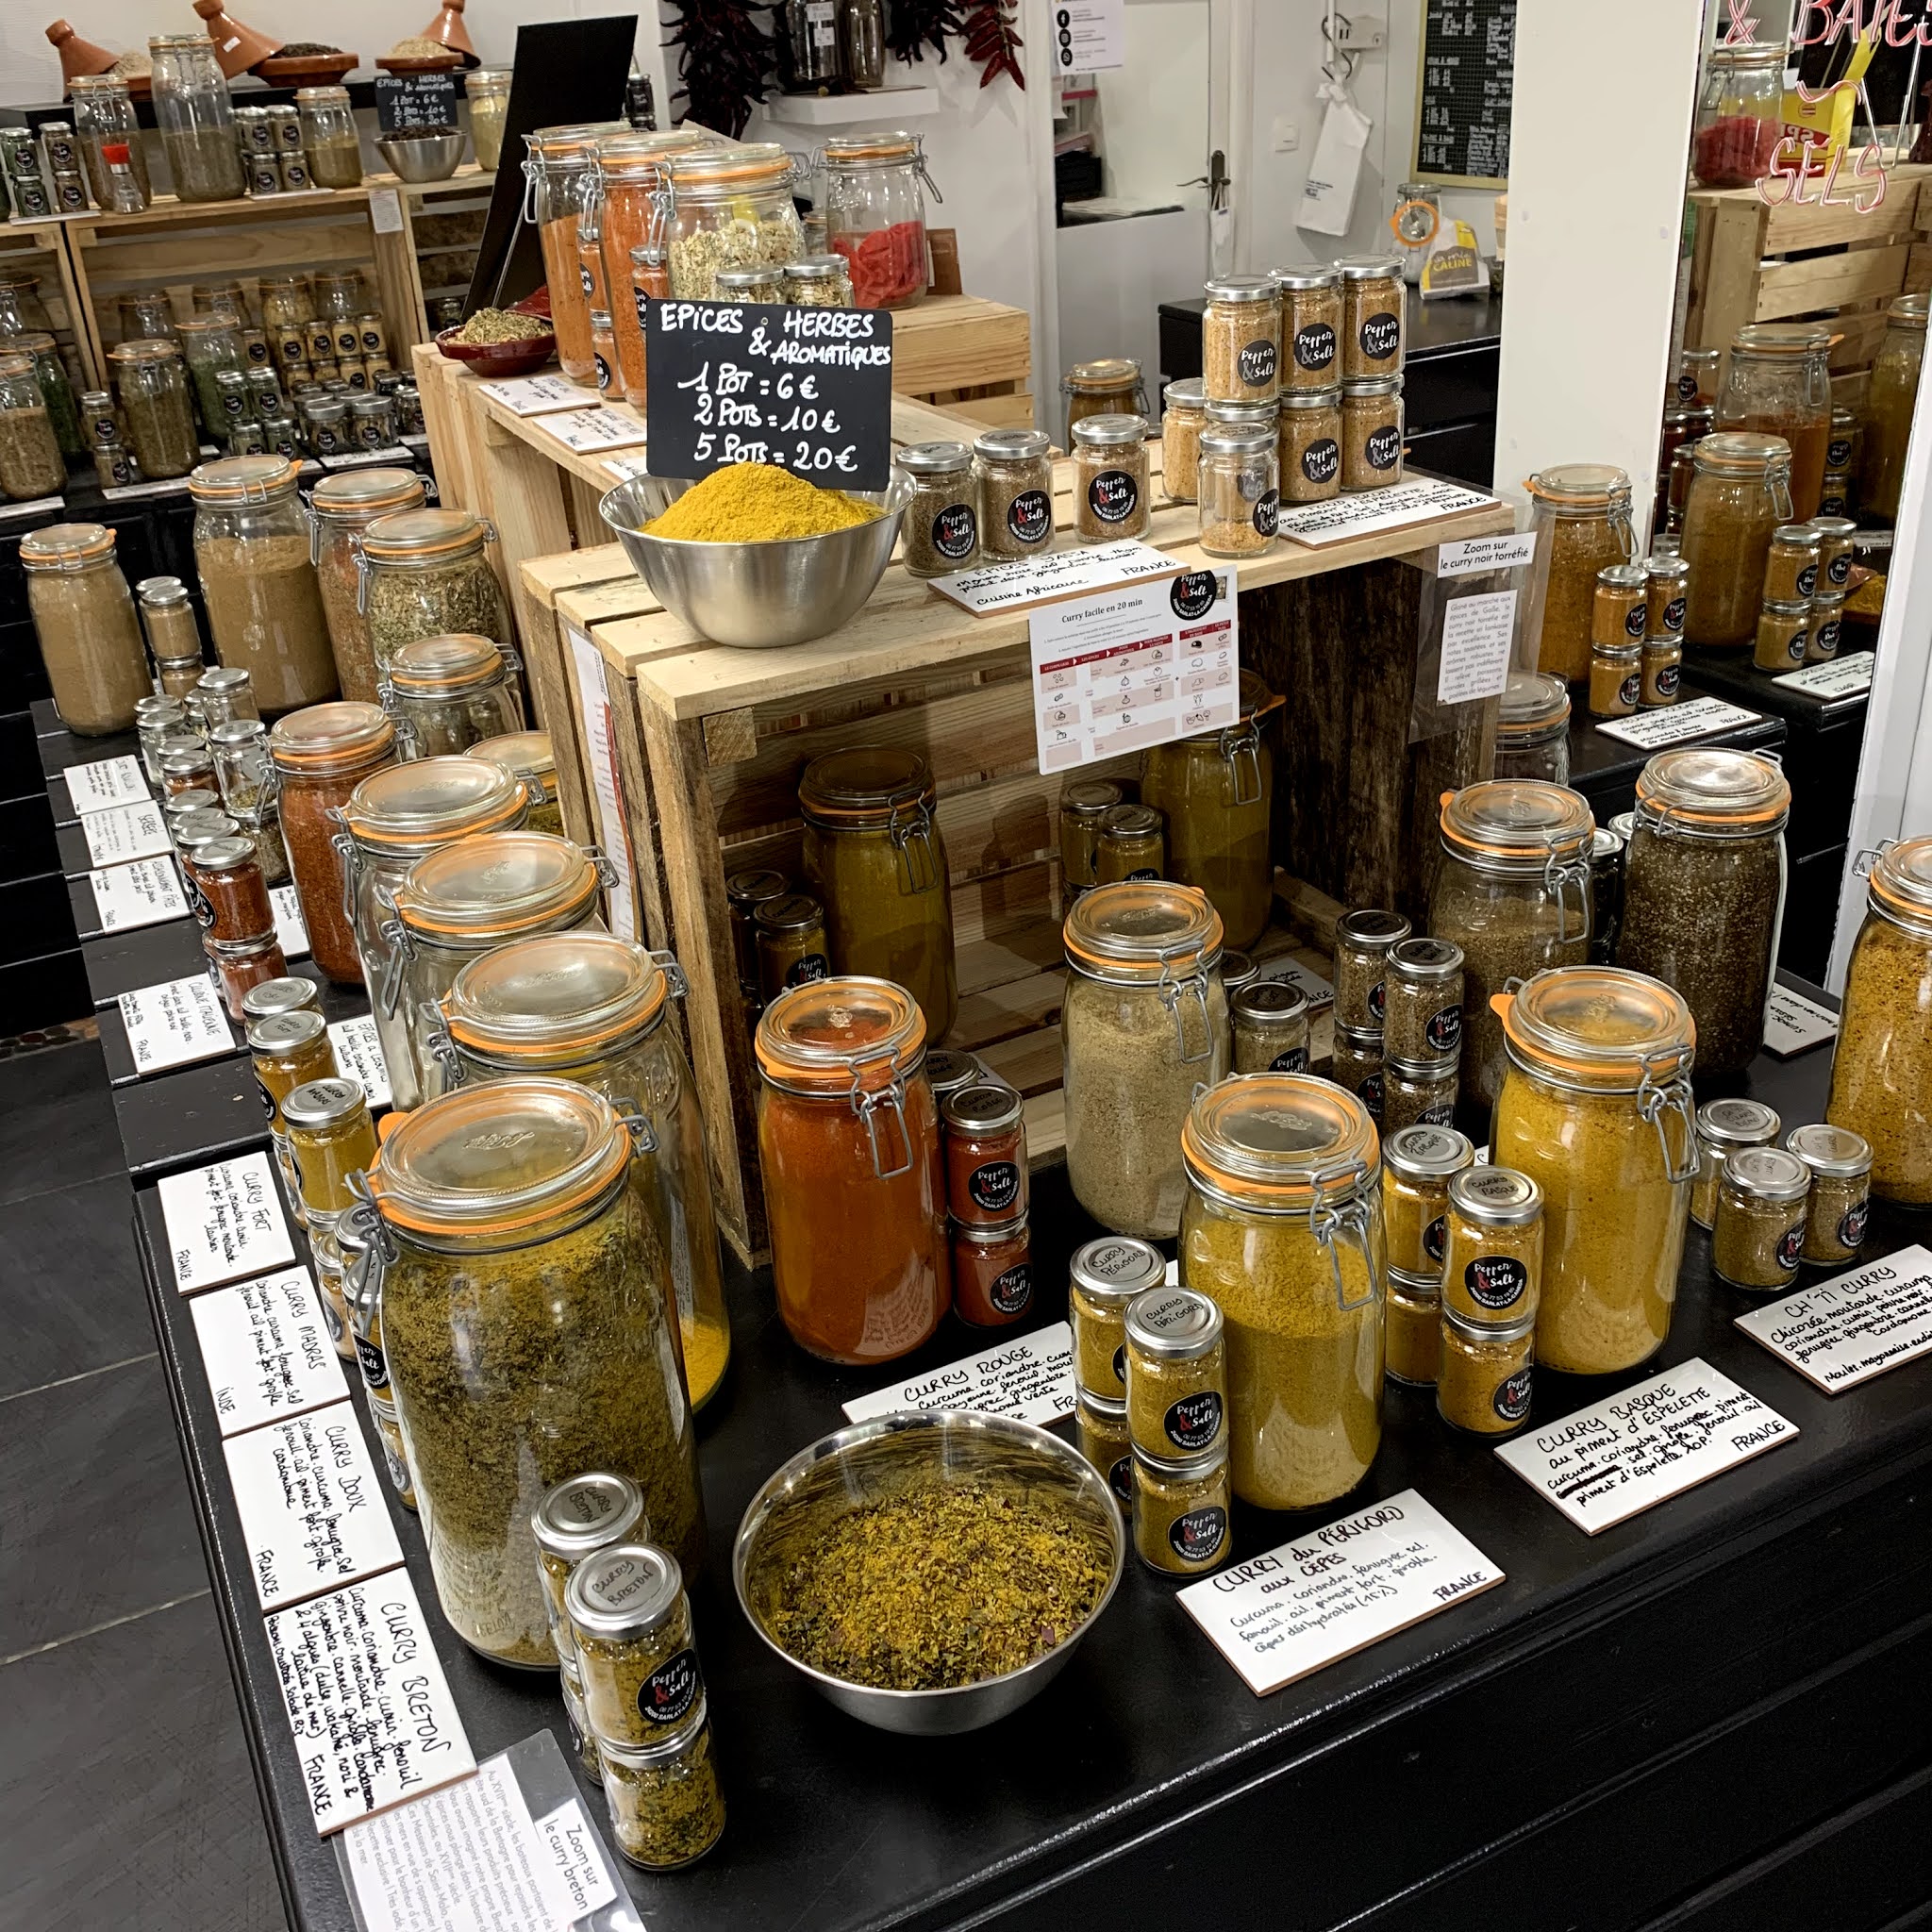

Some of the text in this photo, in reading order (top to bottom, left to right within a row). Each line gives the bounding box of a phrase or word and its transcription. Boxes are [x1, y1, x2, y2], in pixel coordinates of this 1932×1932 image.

[1755, 136, 1887, 214] SELS
[783, 309, 874, 339] HERBES
[1364, 321, 1398, 337] Pepper
[749, 327, 772, 356] &
[1299, 330, 1334, 349] Pepper
[1367, 334, 1398, 355] & Salt
[1241, 344, 1274, 363] Pepper
[1301, 345, 1334, 365] & Salt
[677, 361, 709, 391] 1
[716, 363, 754, 395] POT
[1242, 362, 1274, 380] & Salt
[693, 393, 713, 425] 2
[717, 398, 762, 426] POTS
[693, 432, 717, 460] 5
[717, 434, 768, 463] POTS
[1306, 444, 1337, 462] Pepper
[1308, 458, 1338, 479] & Salt
[1096, 476, 1126, 491] Pepper
[1015, 496, 1043, 511] Pepper
[1099, 488, 1128, 504] & Salt
[1440, 496, 1488, 511] FRANCE
[1017, 508, 1044, 525] & Salt
[1441, 545, 1529, 571] le curry noir torréfié
[1463, 541, 1508, 555] Zoom sur
[1121, 559, 1177, 576] FRANCE
[1180, 573, 1208, 584] Pepper
[1188, 585, 1208, 597] Salt
[1061, 598, 1144, 624] Curry facile en 20 min
[977, 1167, 1008, 1182] Pepper
[991, 1177, 1012, 1191] Salt
[242, 1172, 272, 1231] CURRY FORT
[175, 1249, 192, 1281] FRANCE
[1091, 1246, 1126, 1269] CURRY
[1474, 1263, 1512, 1276] Pepper
[1477, 1273, 1515, 1289] & Salt
[1840, 1266, 1897, 1294] CURRY
[280, 1280, 326, 1370] CURRY MADRAS
[904, 1346, 1033, 1403] CURRY ROUGE
[1176, 1398, 1212, 1417] Pepper
[1537, 1383, 1677, 1454] CURRY BASQUE
[1179, 1409, 1214, 1431] & Salt
[1730, 1420, 1786, 1452] FRANCE
[1549, 1455, 1574, 1470] au
[1574, 1430, 1623, 1460] piment
[325, 1425, 367, 1513] CURRY DOUX
[1575, 1480, 1617, 1507] piment
[1181, 1511, 1218, 1530] Pepper
[1183, 1523, 1218, 1543] & Salt
[256, 1549, 279, 1597] FRANCE
[591, 1559, 635, 1594] CURRY
[1213, 1555, 1284, 1593] CURRY
[1291, 1541, 1322, 1562] du
[608, 1562, 654, 1606] BRETON
[1260, 1574, 1296, 1594] aux
[1432, 1571, 1488, 1603] FRANCE
[1315, 1587, 1356, 1610] piment
[380, 1603, 452, 1753] CURRY BRETON
[652, 1658, 688, 1688] Pepper
[669, 1670, 690, 1697] Salt
[304, 1692, 315, 1708] de
[304, 1753, 333, 1816] FRANCE
[343, 1786, 359, 1799] &
[542, 1817, 589, 1911] le curry breton
[564, 1824, 600, 1888] Zoom sur
